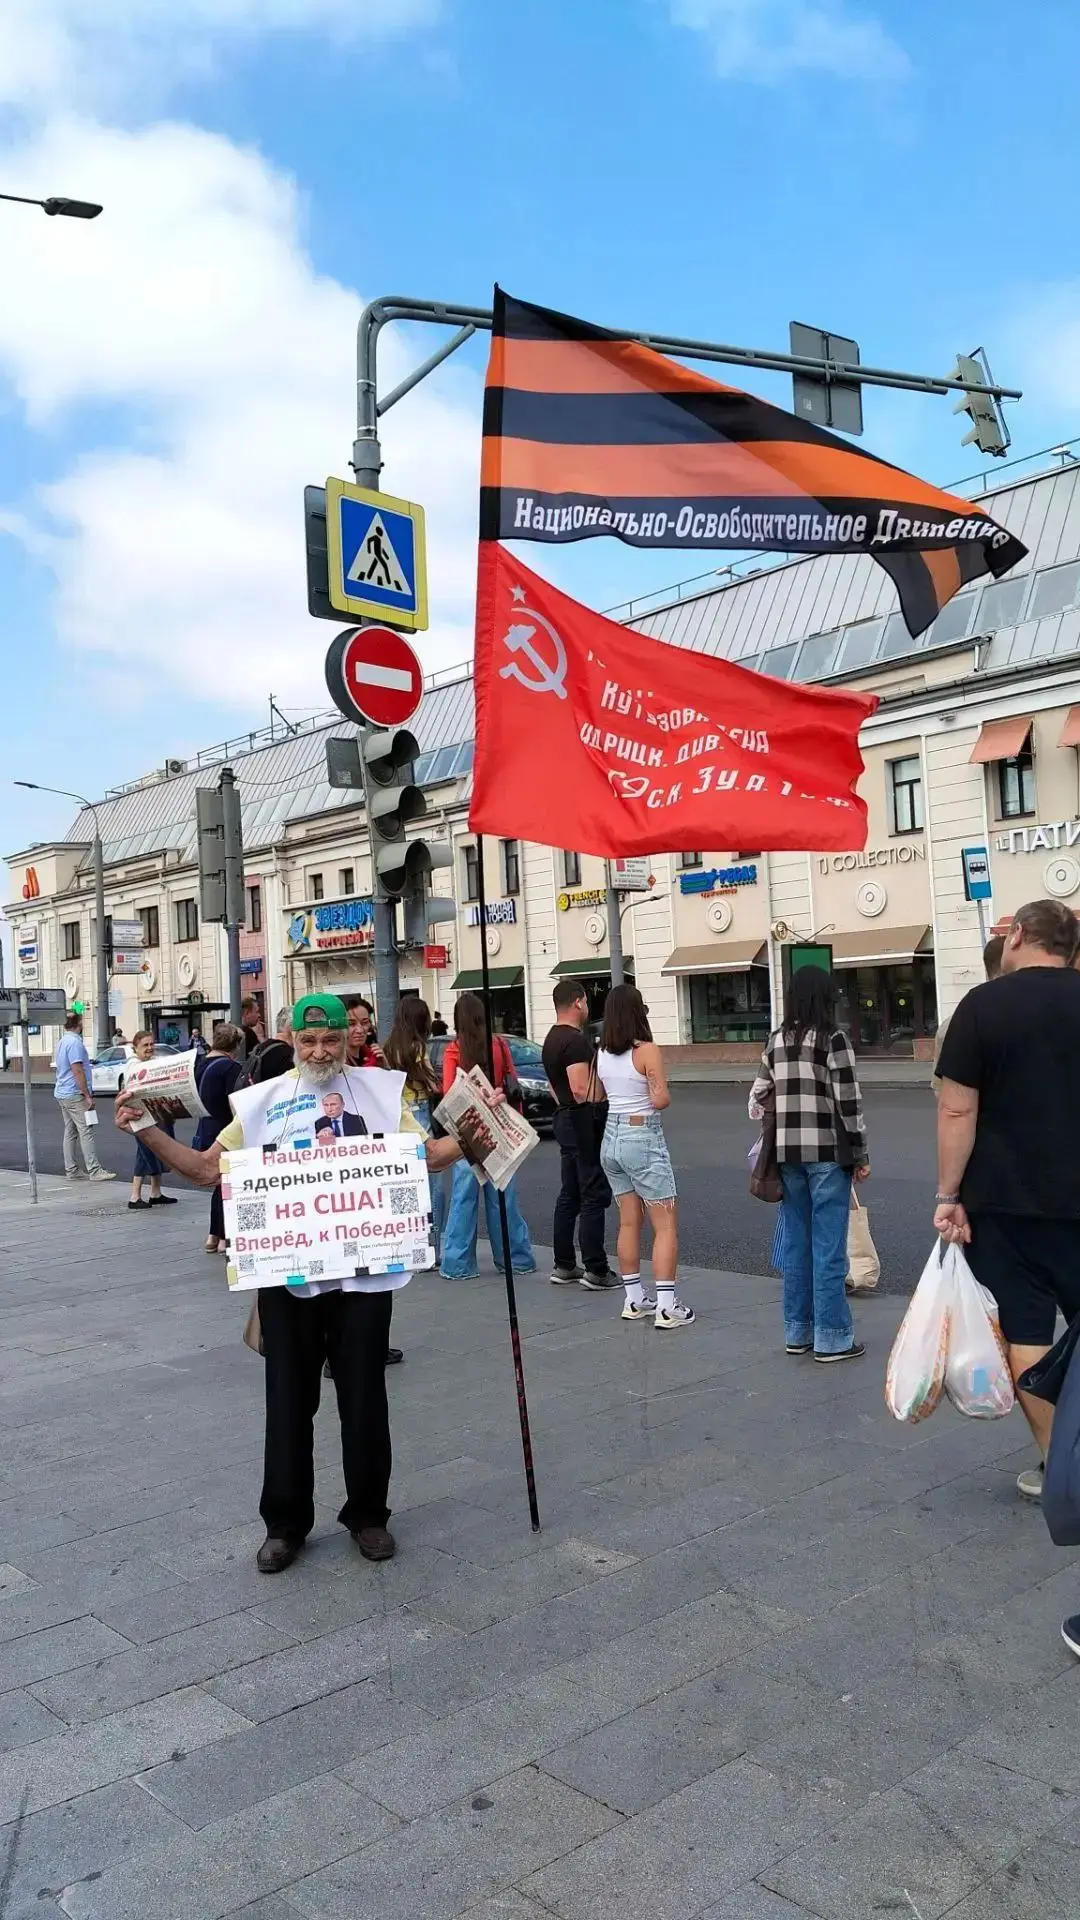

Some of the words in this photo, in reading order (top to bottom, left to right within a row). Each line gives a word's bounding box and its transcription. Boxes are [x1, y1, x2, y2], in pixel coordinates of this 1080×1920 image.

[514, 497, 867, 542] Национально-Освободительное
[817, 858, 829, 875] TJ
[832, 842, 926, 872] COLLECTION
[719, 864, 757, 884] PEGAS
[571, 890, 600, 902] FRENCH
[314, 900, 375, 930] ЗВЕЗДОЧ
[488, 911, 514, 924] ГОРОД
[316, 931, 364, 949] ТОРГОВЫЙ
[262, 1140, 387, 1166] Нацеливаем
[243, 1170, 333, 1192] ядерные
[340, 1163, 409, 1183] ракеты
[275, 1201, 306, 1220] на
[314, 1187, 384, 1216] США!
[235, 1232, 314, 1253] Вперёд,
[319, 1230, 330, 1243] к
[335, 1215, 427, 1241] Победе!!!
